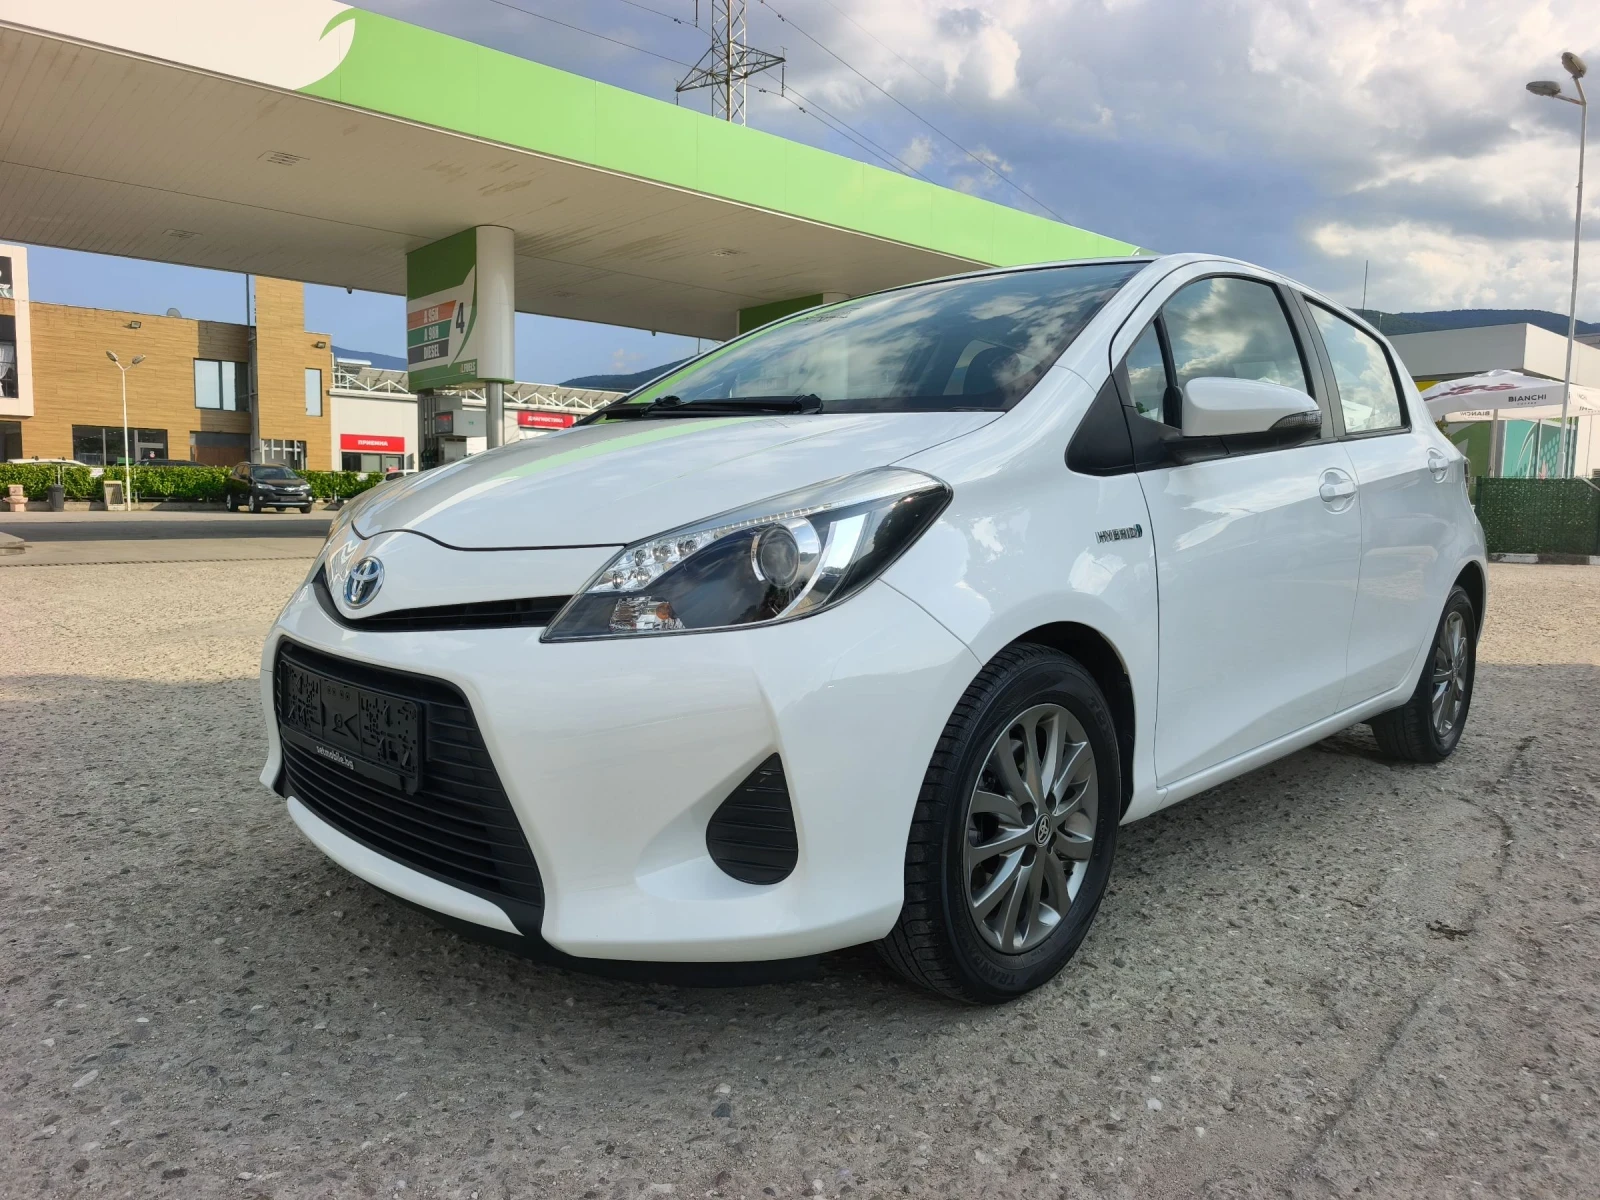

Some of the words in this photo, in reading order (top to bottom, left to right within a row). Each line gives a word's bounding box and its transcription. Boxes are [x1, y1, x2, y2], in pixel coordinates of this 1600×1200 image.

[455, 302, 465, 334] 4
[423, 344, 440, 360] DIESEL
[1508, 393, 1547, 403] BIANCHI
[1094, 527, 1138, 544] HYBRID
